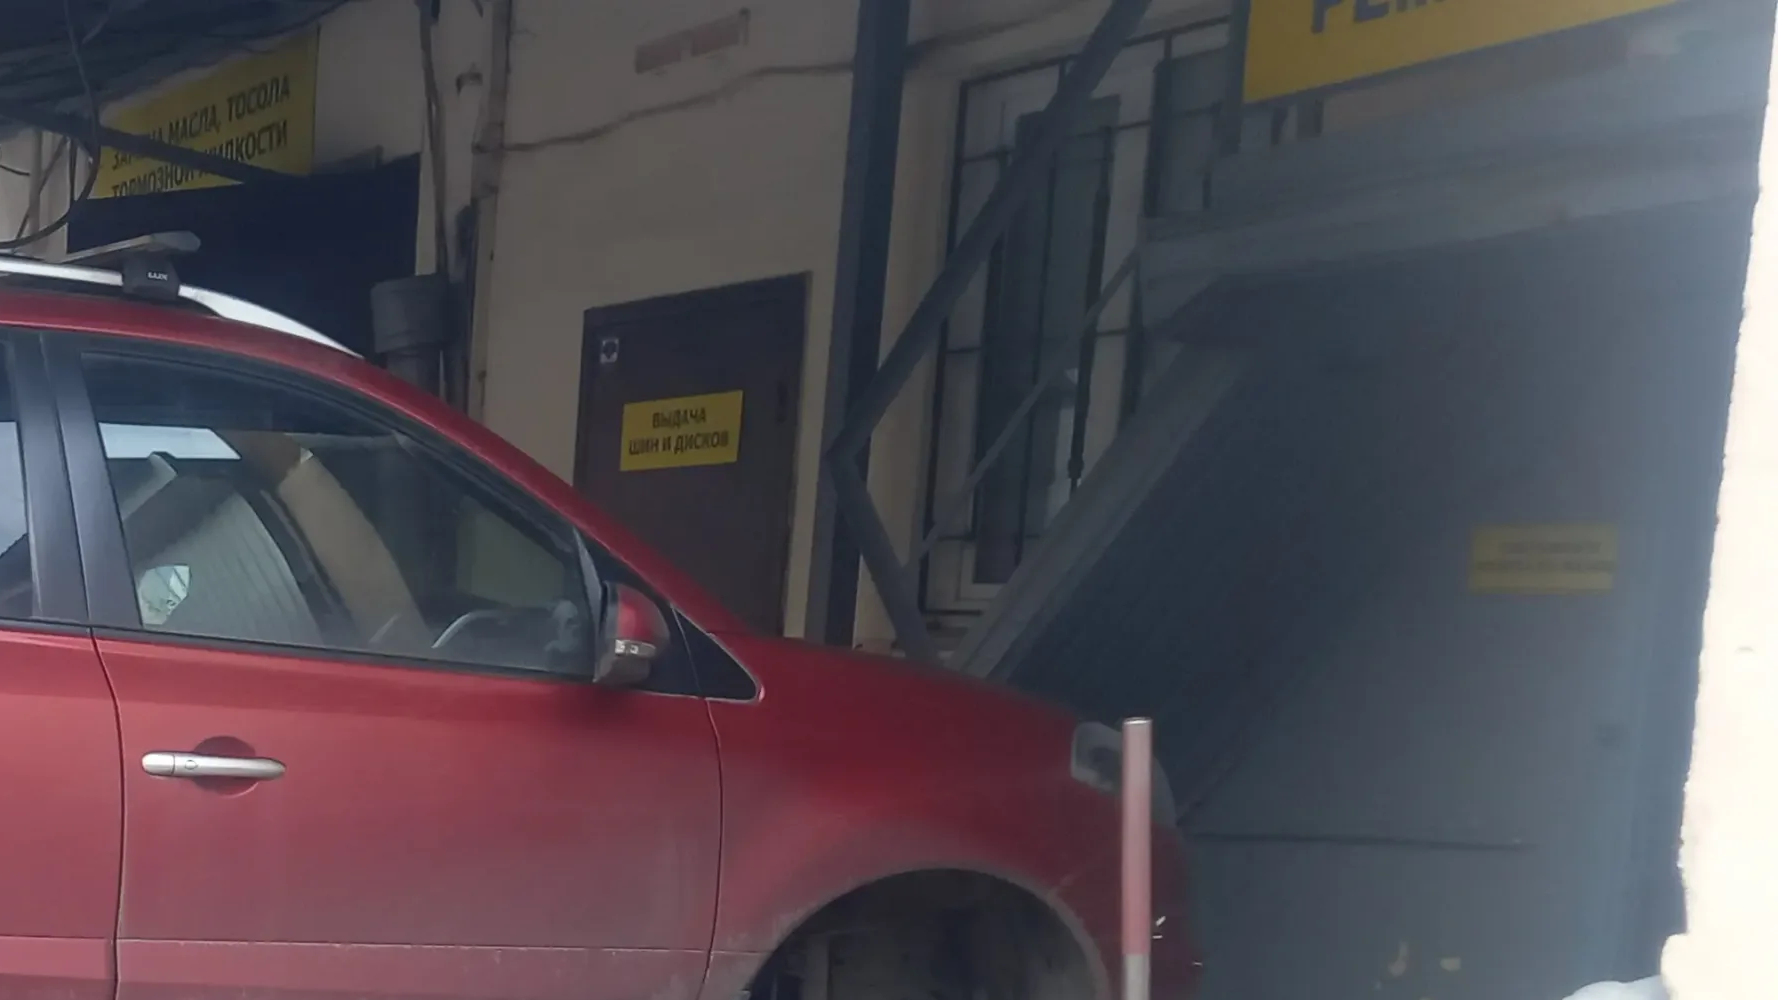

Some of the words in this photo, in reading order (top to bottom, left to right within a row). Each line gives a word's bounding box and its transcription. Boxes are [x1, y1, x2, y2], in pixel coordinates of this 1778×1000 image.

[227, 75, 290, 122] ТОСОЛА
[652, 407, 707, 429] ВЫДАЧА
[629, 436, 660, 456] ШИН
[662, 435, 672, 452] И
[674, 430, 729, 455] ДИСКОВ
